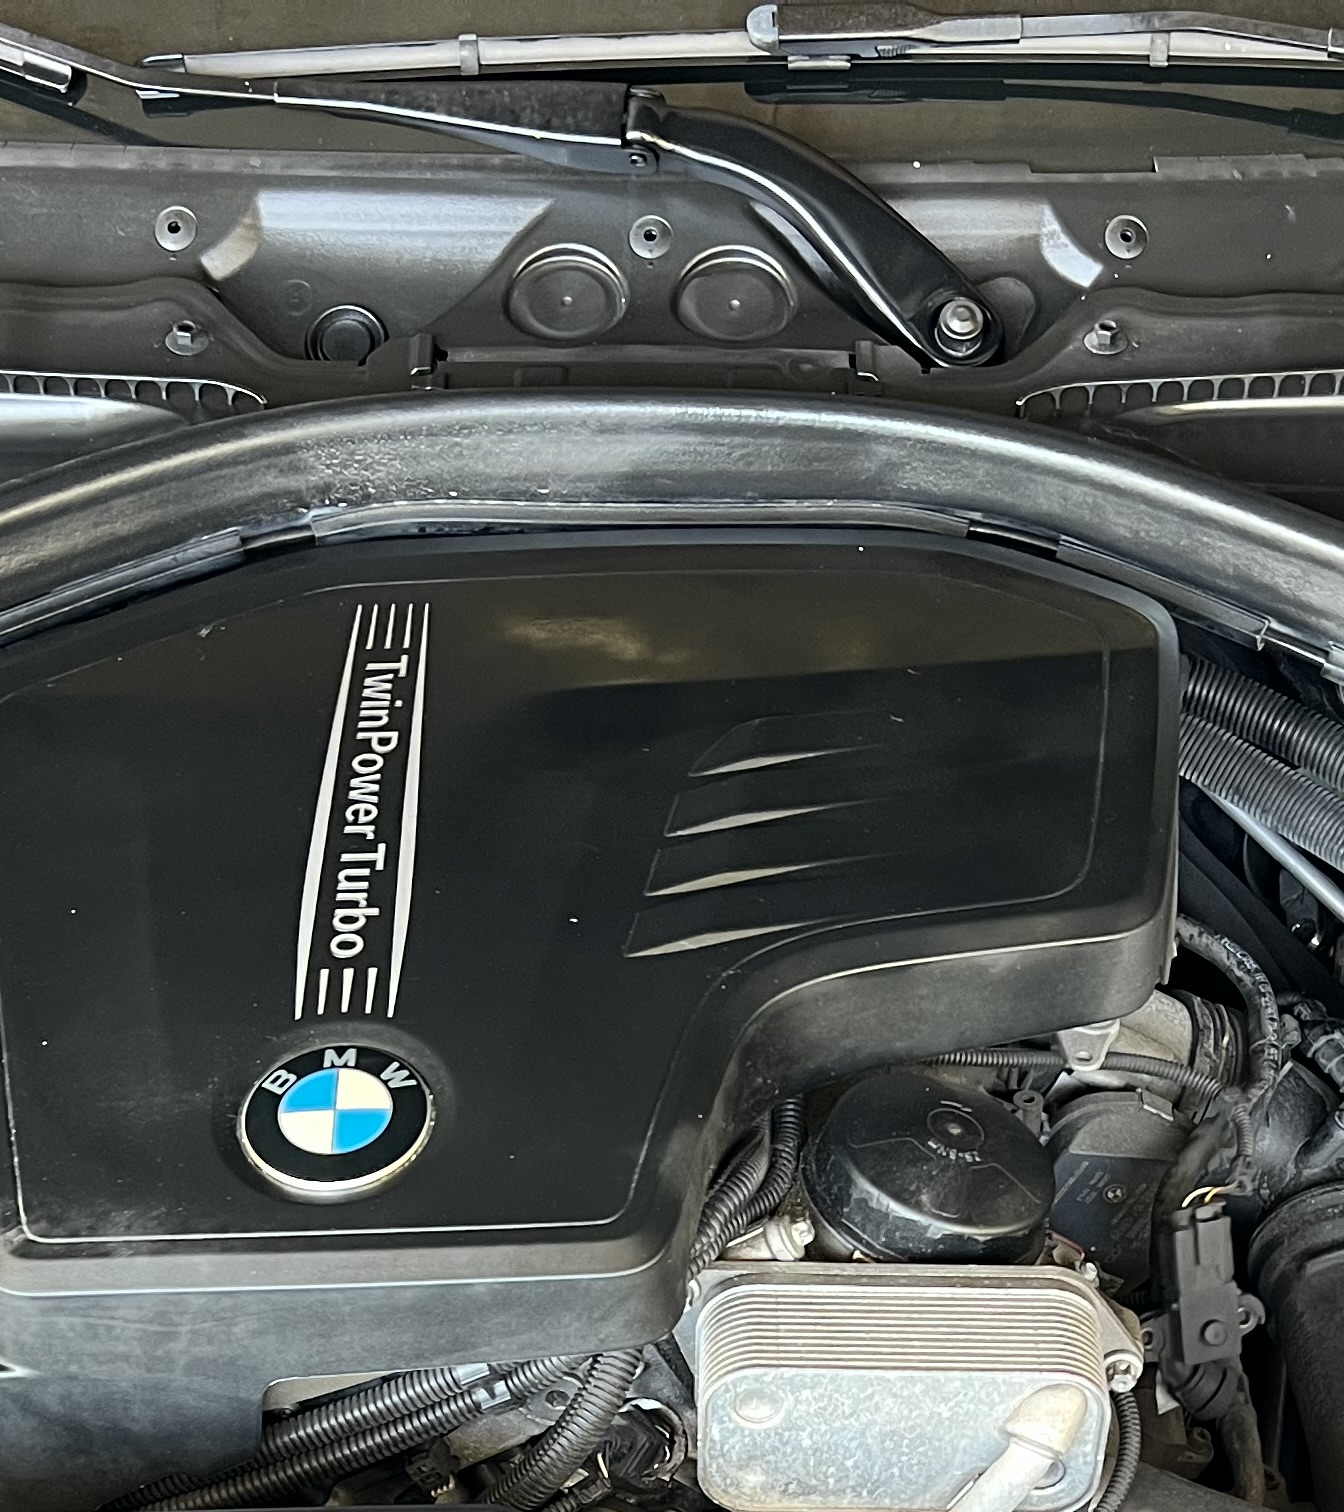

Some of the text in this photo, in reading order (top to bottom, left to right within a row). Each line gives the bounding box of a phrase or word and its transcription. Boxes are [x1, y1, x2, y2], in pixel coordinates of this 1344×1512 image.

[329, 654, 410, 960] TwinPower Turbo
[261, 1047, 419, 1096] BMW
